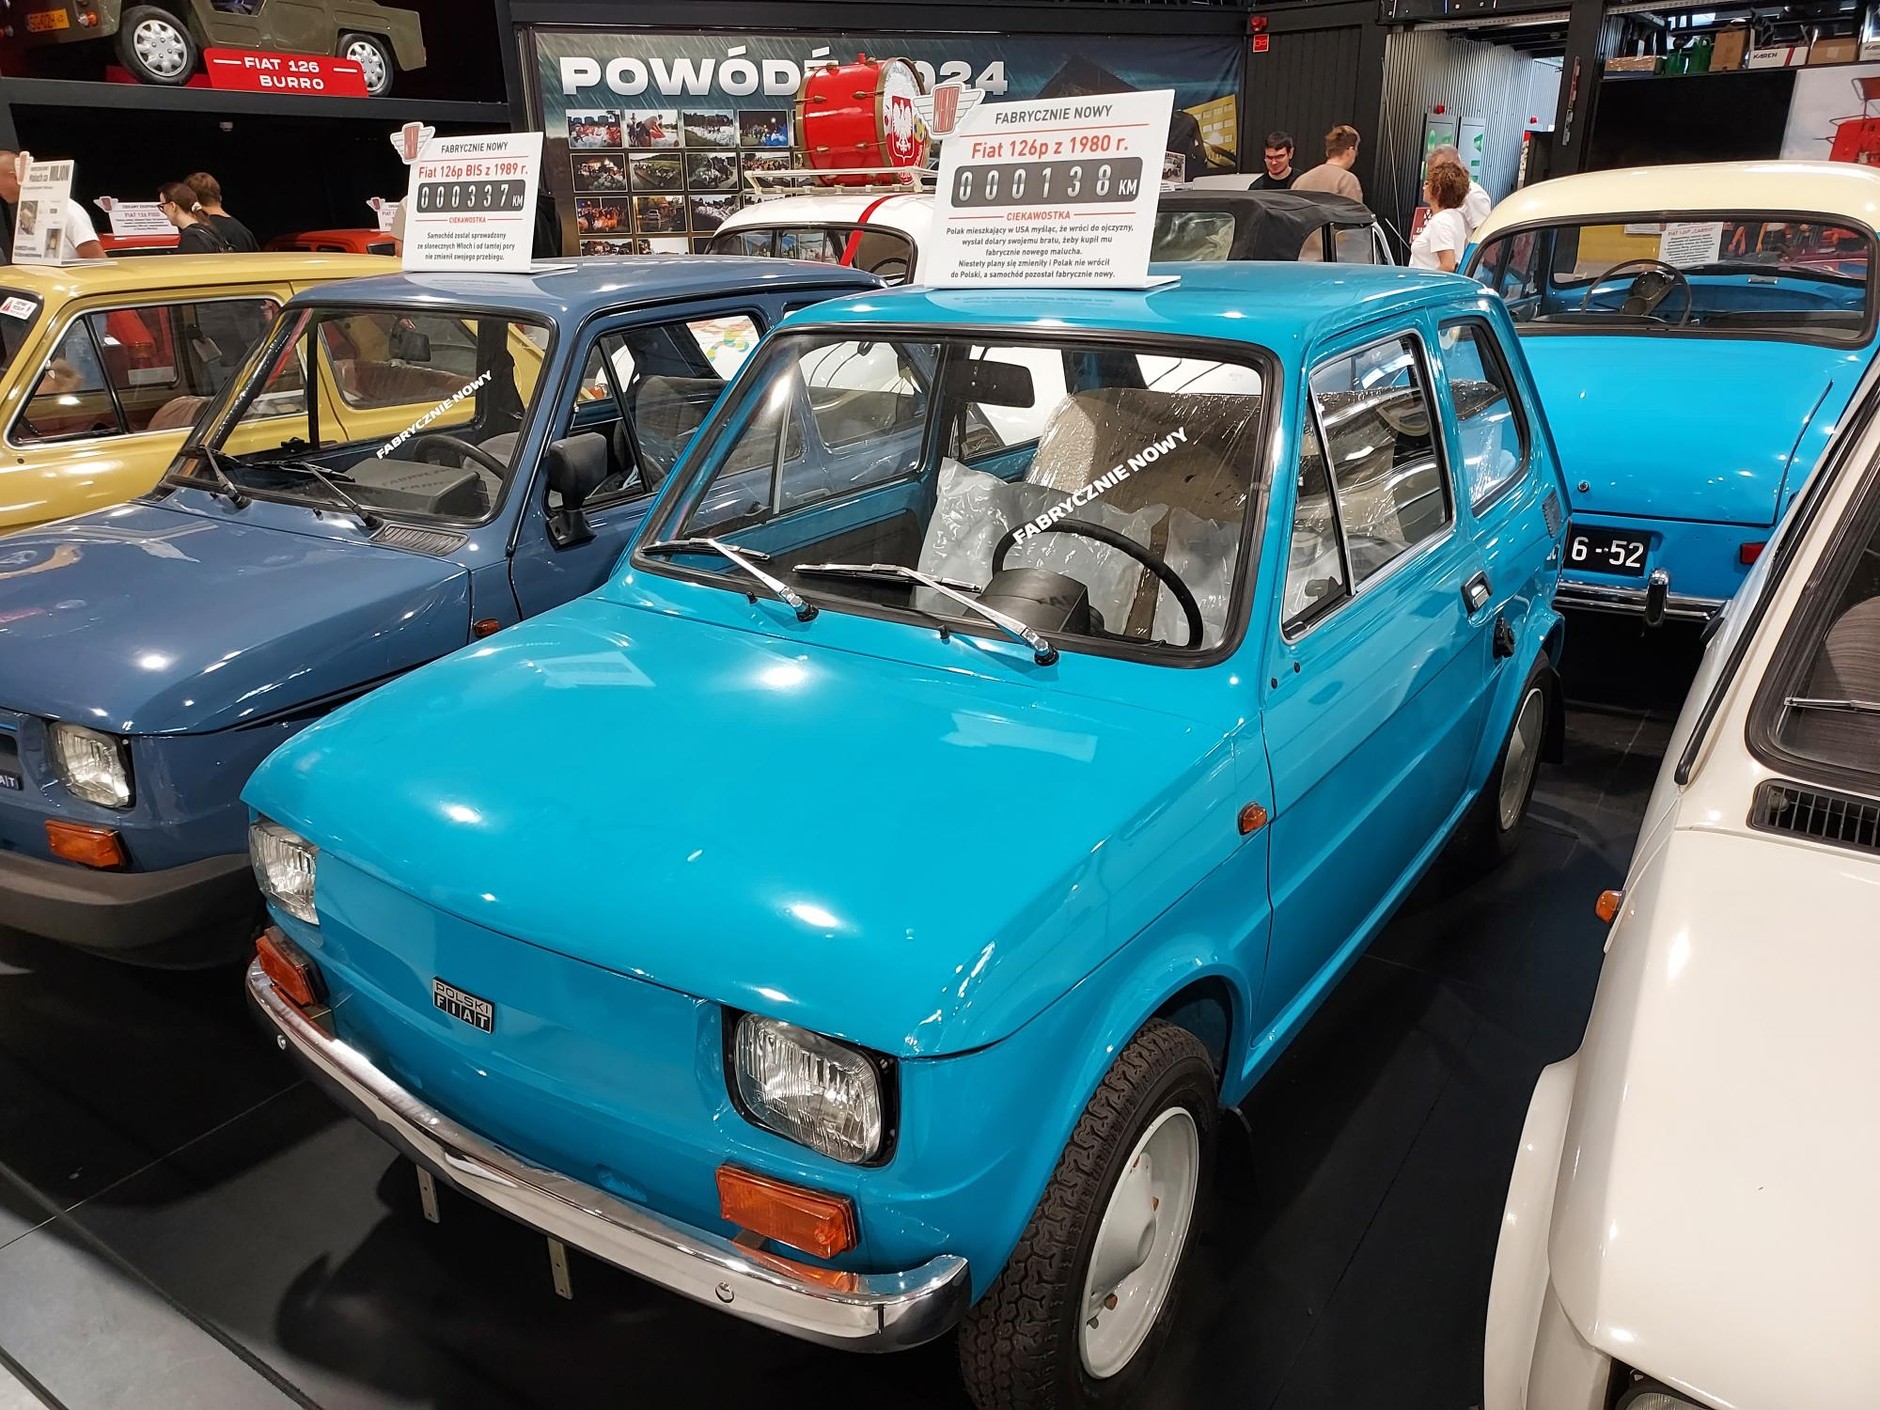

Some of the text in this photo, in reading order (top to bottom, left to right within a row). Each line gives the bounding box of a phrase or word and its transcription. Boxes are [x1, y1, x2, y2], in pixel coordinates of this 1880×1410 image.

[243, 56, 320, 73] FIAT 126
[258, 74, 325, 90] BURRO
[916, 60, 1009, 96] 024
[995, 105, 1113, 124] FABRYCZNIE NOWY
[442, 142, 509, 154] FABRYCZNIE NOWY
[971, 134, 1129, 159] Fiat 126p z 1980 r.
[418, 163, 528, 180] Fiat 126p BIS z 1989 r.
[1118, 179, 1138, 196] KM
[512, 195, 523, 206] KM
[1006, 211, 1071, 221] CIEKAWOSTKA
[471, 232, 506, 240] sprowadzony
[946, 227, 965, 235] Polak
[966, 226, 1006, 236] mieszkający
[1015, 226, 1030, 234] USA
[1031, 225, 1057, 235] myśląc,
[1059, 225, 1067, 233] że
[1069, 224, 1089, 232] wróci
[1101, 224, 1134, 232] ojczyzny,
[962, 238, 983, 246] wysłał
[985, 237, 1006, 245] dolary
[1008, 236, 1038, 245] swojemu
[1062, 236, 1080, 244] żeby
[1081, 235, 1099, 243] kupił
[986, 248, 1020, 256] fabrycznie
[959, 260, 986, 268] Niestety
[987, 259, 1005, 268] plany
[1007, 259, 1016, 268] się
[1018, 259, 1048, 267] zmieniły
[1087, 258, 1110, 266] wrócił
[960, 271, 982, 279] Polski,
[989, 270, 1023, 278] samochód
[1025, 271, 1054, 279] pozostał
[1056, 270, 1093, 278] fabrycznie
[1094, 271, 1115, 279] nowy.
[375, 369, 493, 460] FABRYCZNIE NOWY
[1012, 426, 1189, 545] FABRYCZNIE NOWY
[435, 982, 489, 1014] POLSKI
[436, 994, 488, 1028] FIAT
